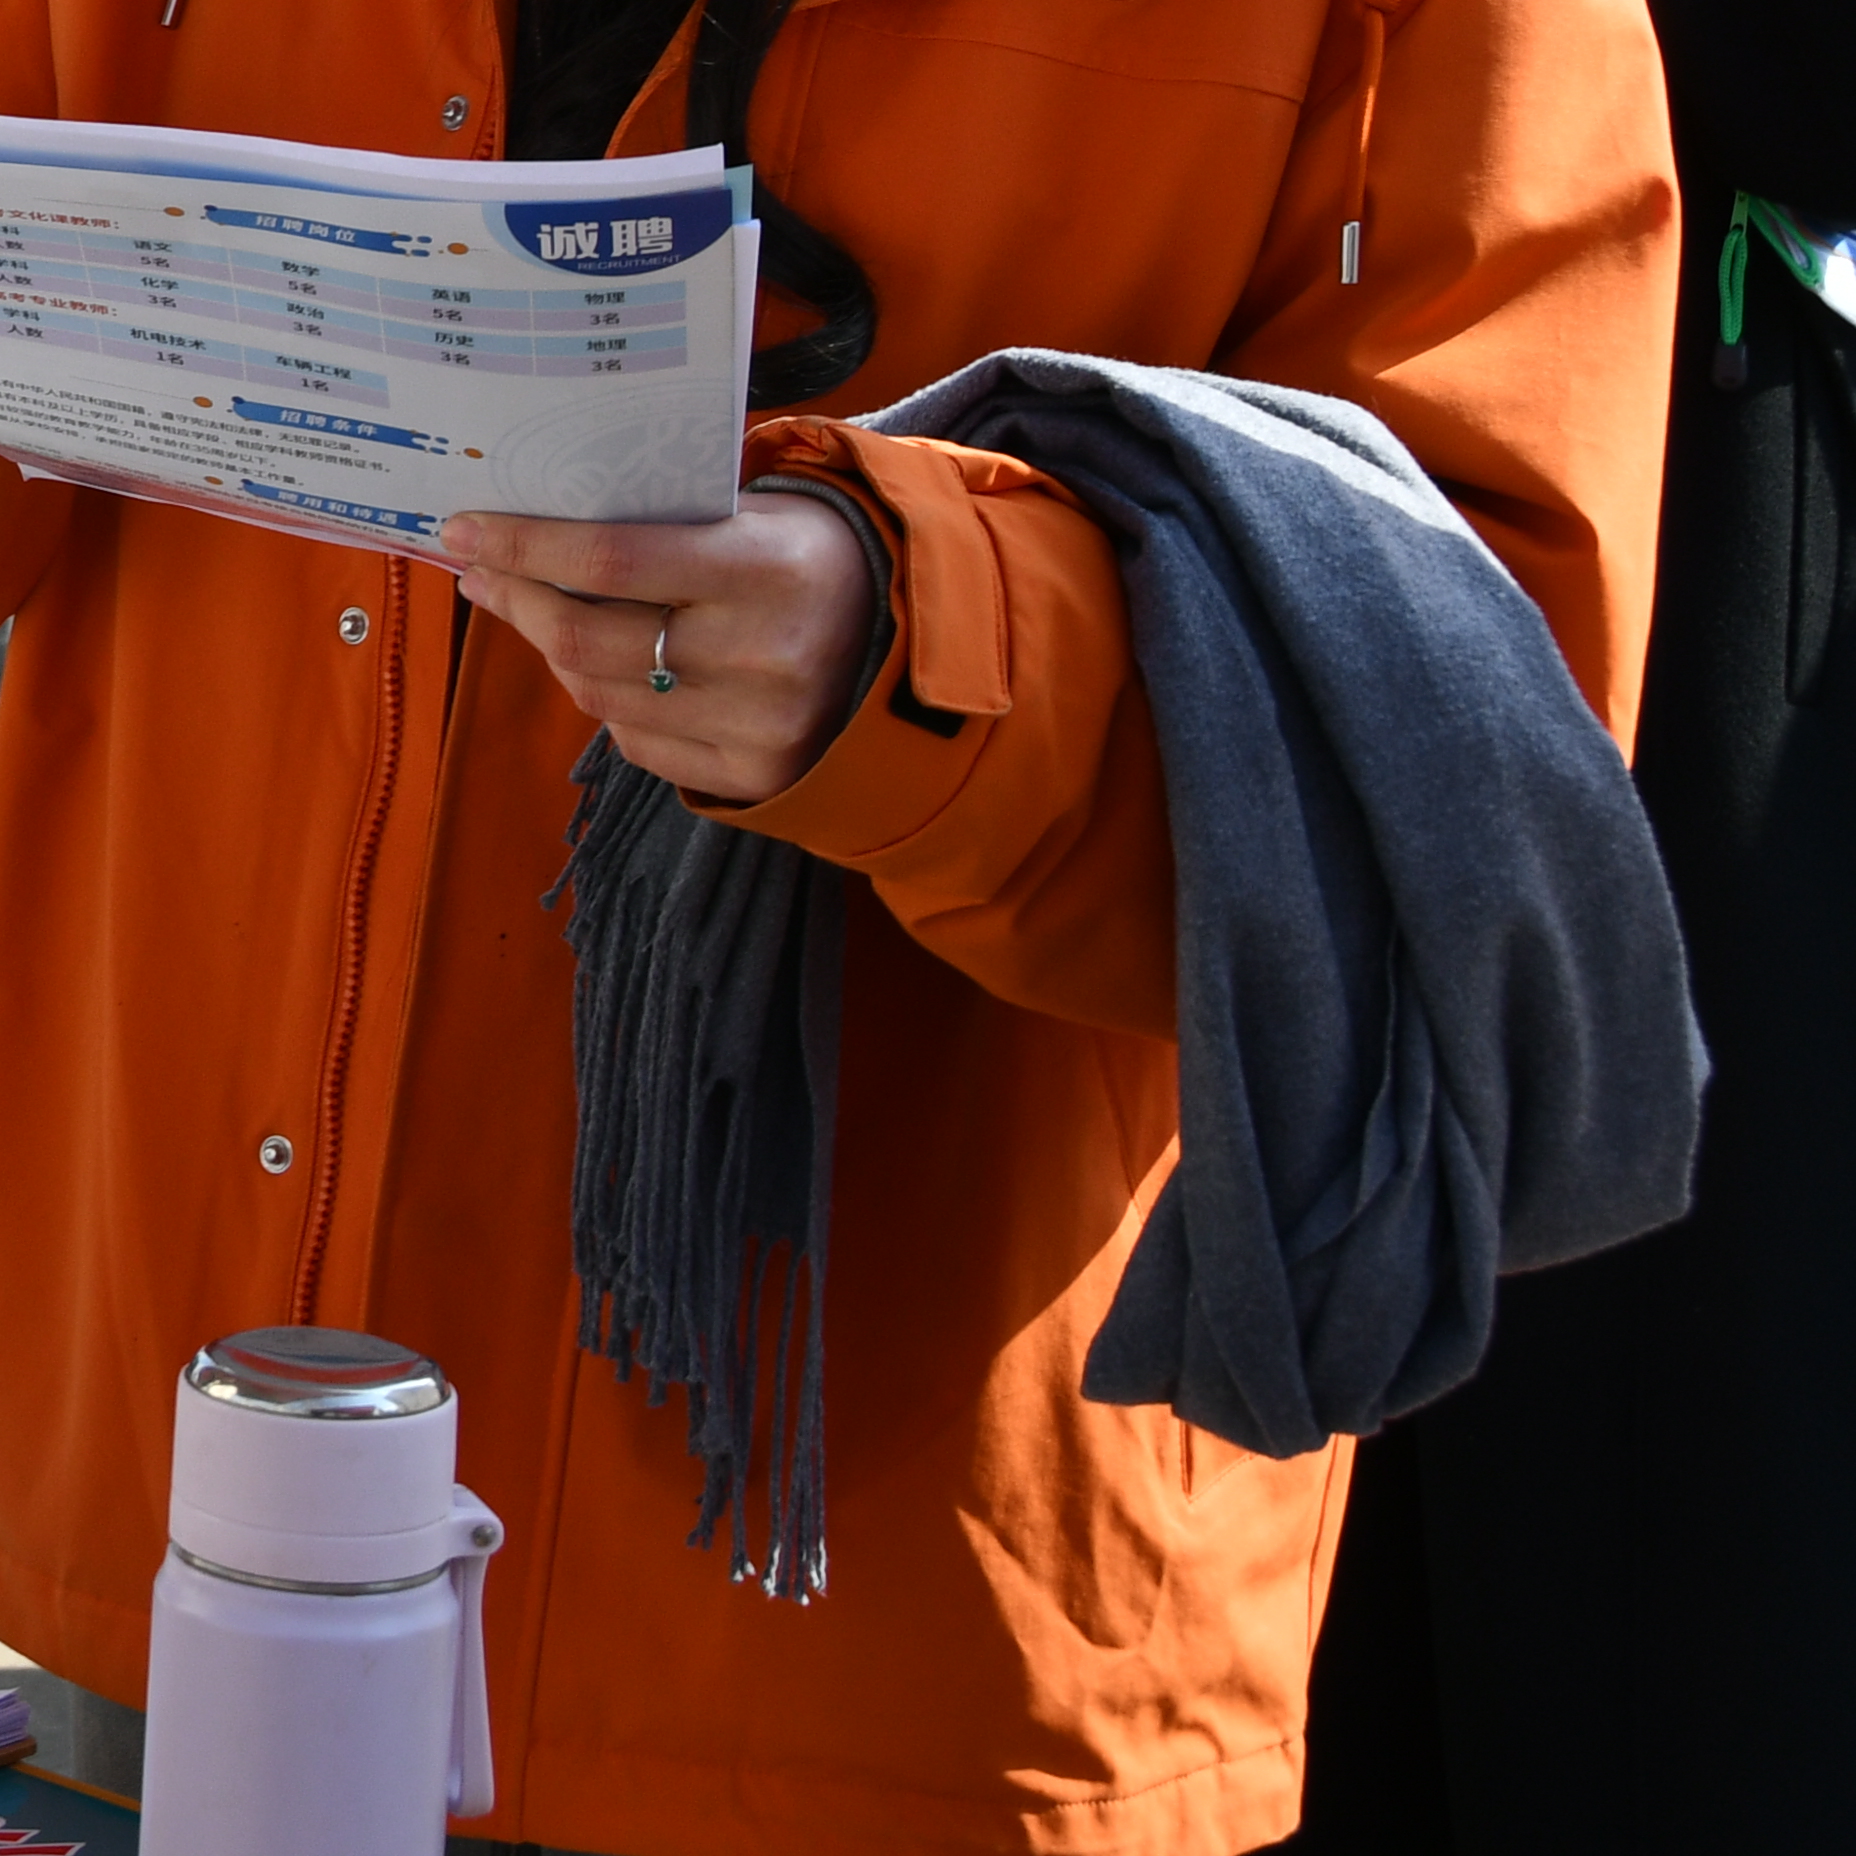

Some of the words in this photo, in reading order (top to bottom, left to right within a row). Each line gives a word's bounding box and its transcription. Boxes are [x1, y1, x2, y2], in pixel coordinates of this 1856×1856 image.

[255, 214, 356, 243] 招聘岗位
[536, 217, 674, 261] 诚聘
[134, 239, 173, 253] 语文
[282, 261, 320, 277] 数学
[432, 288, 471, 304] 英语
[584, 291, 626, 305] 物理
[141, 256, 170, 269] 5名
[288, 280, 317, 296] 5名
[433, 308, 463, 323] 5名
[589, 312, 621, 326] 3名
[577, 253, 682, 272] RECRUITMENT
[2, 307, 40, 322] 学科
[130, 327, 207, 350] 机电技术
[275, 355, 352, 380] 车辆工程
[142, 276, 180, 291] 化学
[286, 302, 325, 320] 政治
[434, 331, 475, 348] 历史
[587, 338, 628, 352] 地理
[148, 295, 177, 309] 3名
[293, 321, 322, 338] 3名
[440, 350, 470, 366] 3名
[591, 358, 622, 373] 3名
[7, 324, 44, 339] 人数
[157, 351, 185, 365] 1名
[301, 377, 329, 392] 1名
[280, 408, 378, 437] 招聘条件
[277, 490, 398, 524] 聘用和待遇
